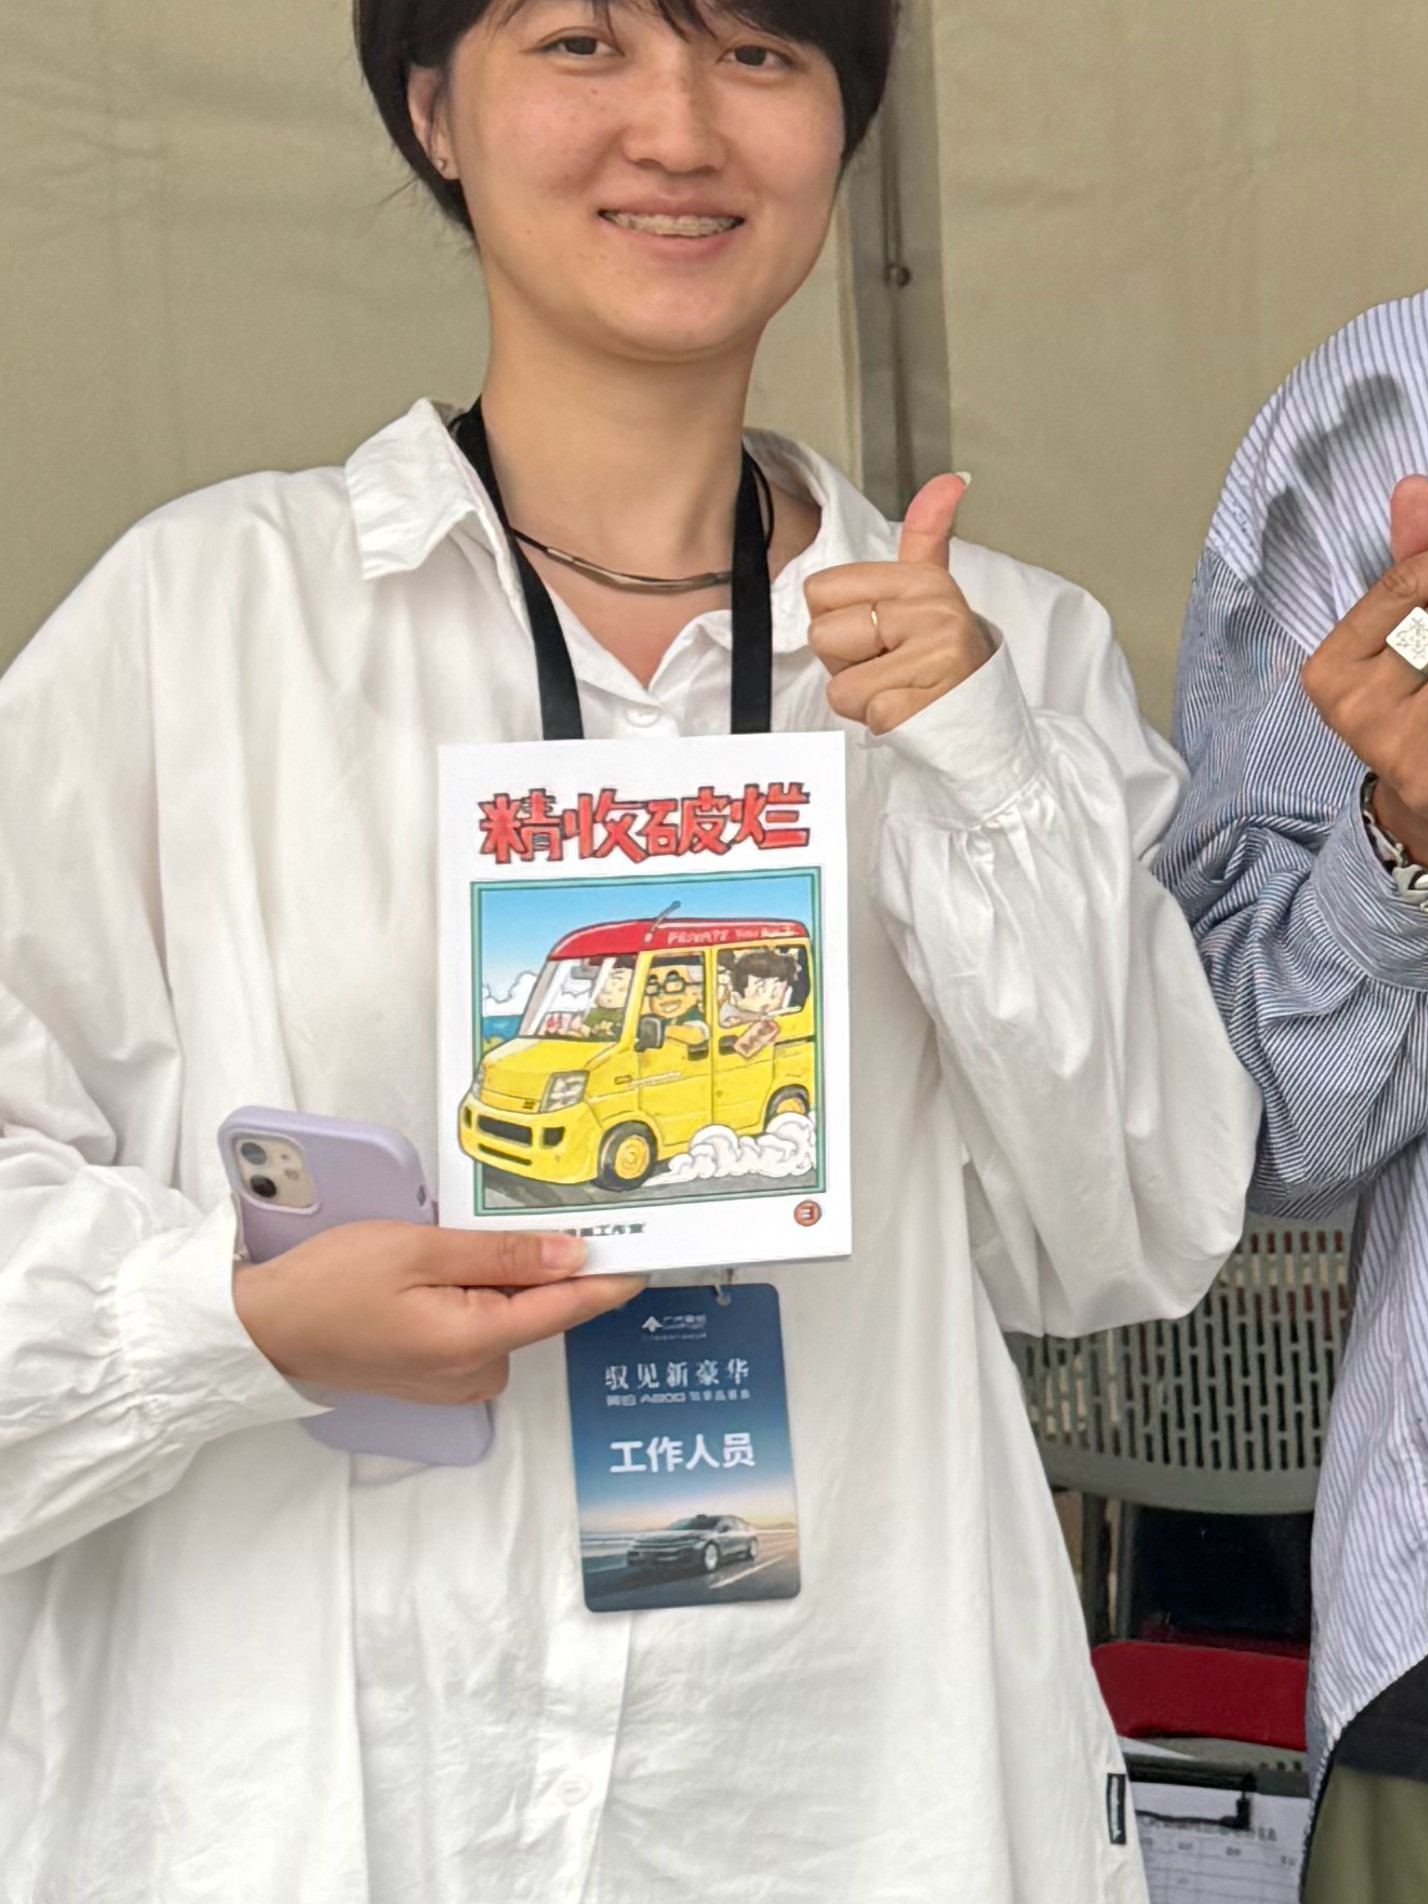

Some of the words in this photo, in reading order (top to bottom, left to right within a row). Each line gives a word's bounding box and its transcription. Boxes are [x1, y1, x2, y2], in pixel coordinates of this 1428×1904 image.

[478, 782, 811, 864] 精收破烂
[609, 1432, 756, 1473] 工作人员
